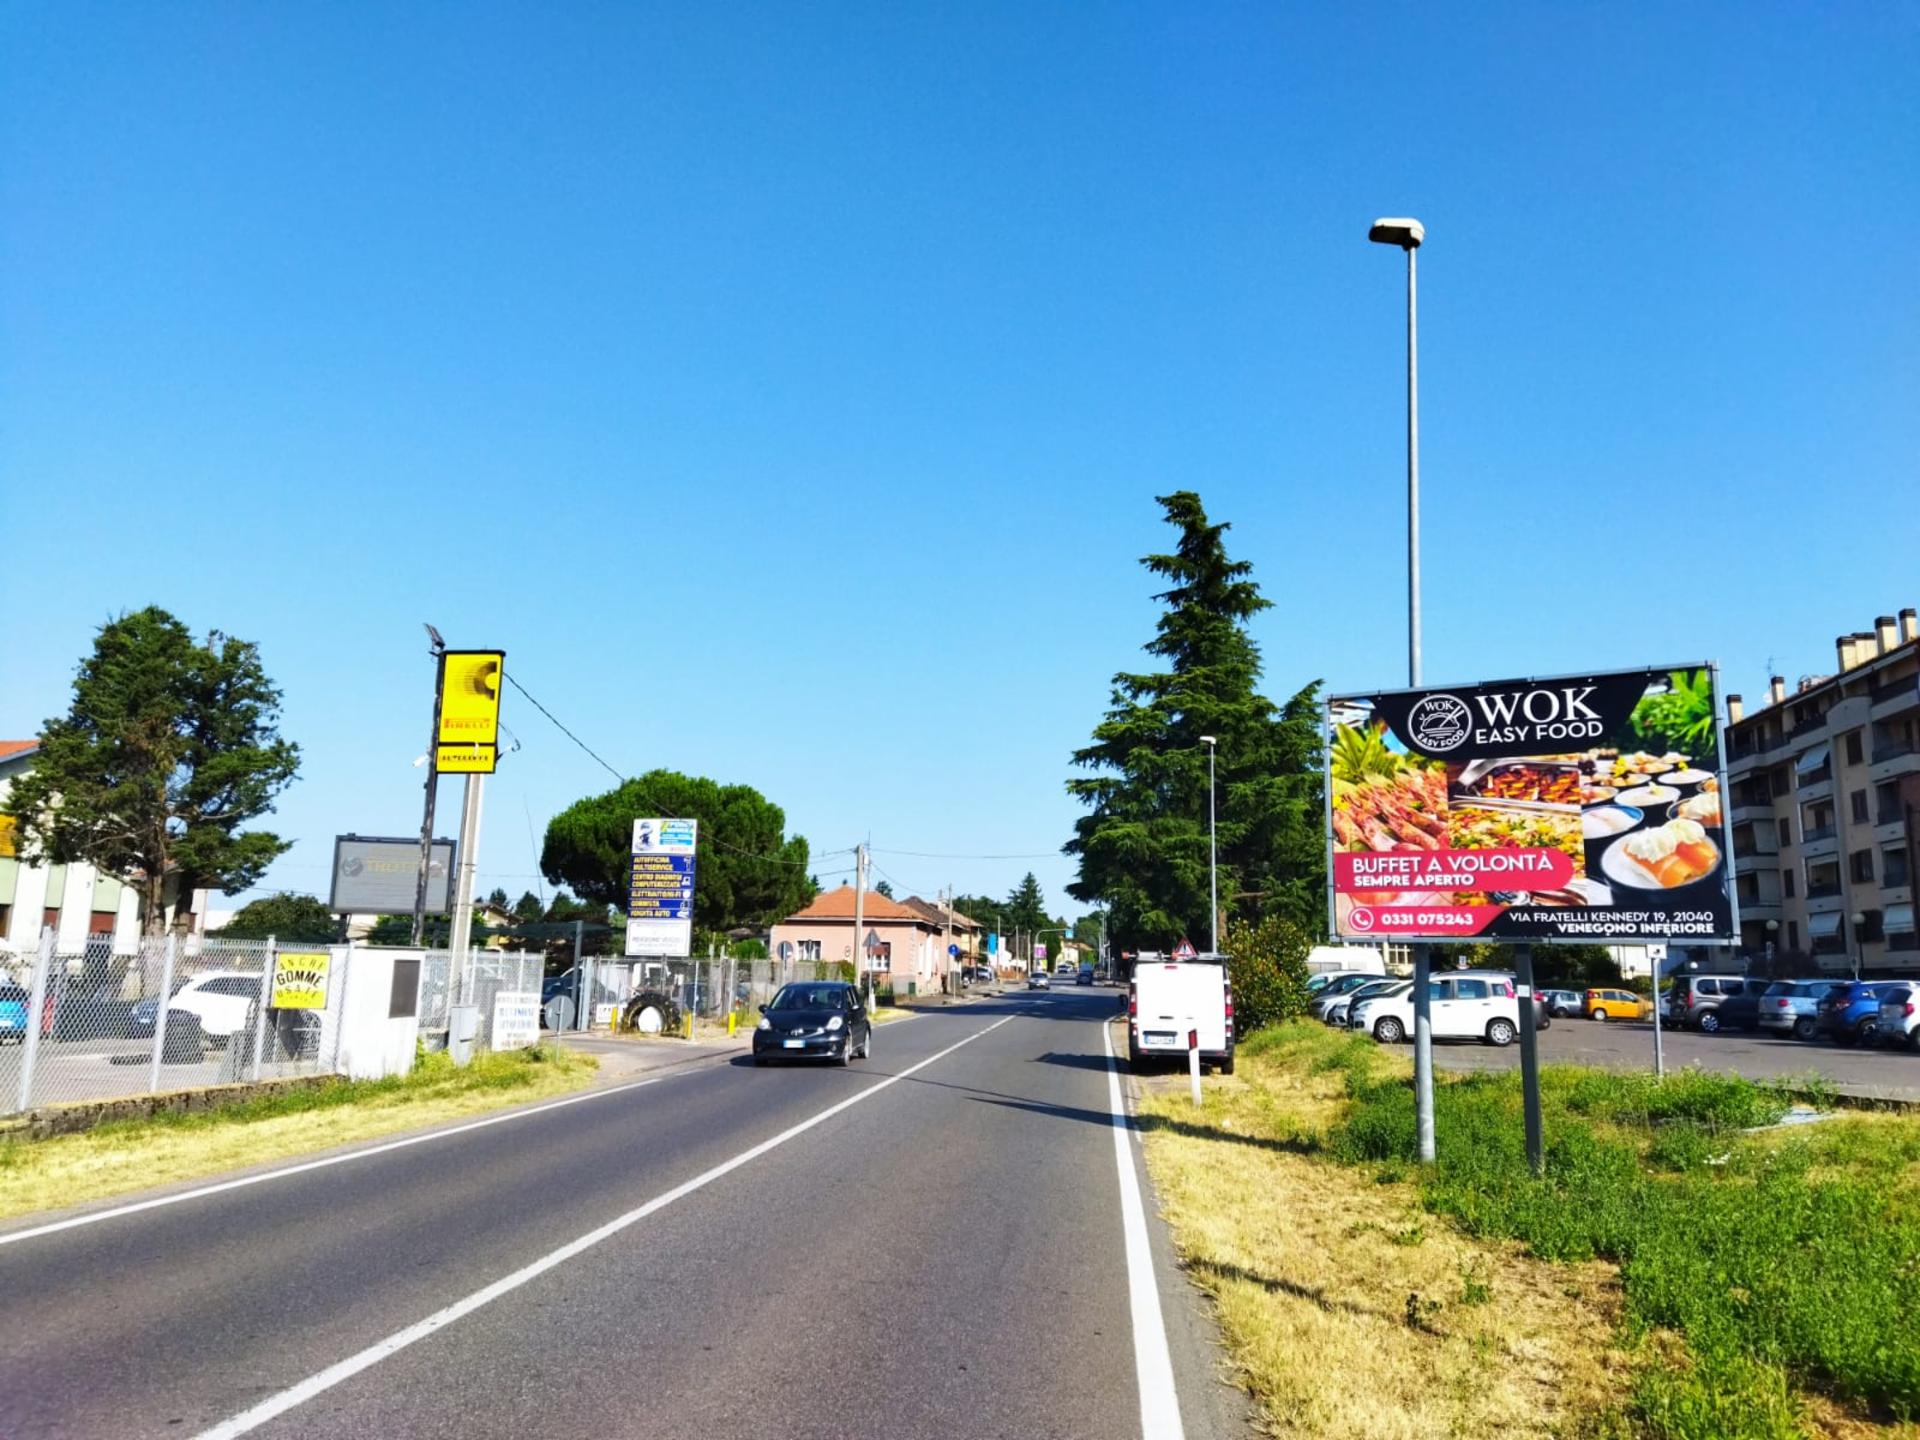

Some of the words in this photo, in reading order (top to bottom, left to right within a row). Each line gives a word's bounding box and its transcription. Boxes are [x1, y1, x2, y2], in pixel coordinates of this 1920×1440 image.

[1424, 700, 1455, 712] WOK
[1474, 686, 1602, 727] WOK
[1417, 733, 1438, 747] EASY
[1440, 729, 1465, 747] FOOD
[1475, 726, 1529, 744] EASY
[1535, 721, 1603, 740] FOOD
[1352, 856, 1422, 873] BUFFET
[1427, 856, 1442, 872] A
[1354, 875, 1410, 887] SEMPRE
[1414, 874, 1475, 886] APERTO
[1381, 913, 1414, 925] 0331
[1417, 913, 1474, 925] 075243
[1509, 912, 1531, 922] VIA
[1534, 912, 1588, 922] FRATELLI
[1591, 912, 1650, 922] KENNEDY
[1673, 911, 1713, 921] 21040
[1557, 923, 1637, 933] VENEGONO
[1640, 922, 1715, 933] INFERIORE
[276, 970, 324, 988] GOMME
